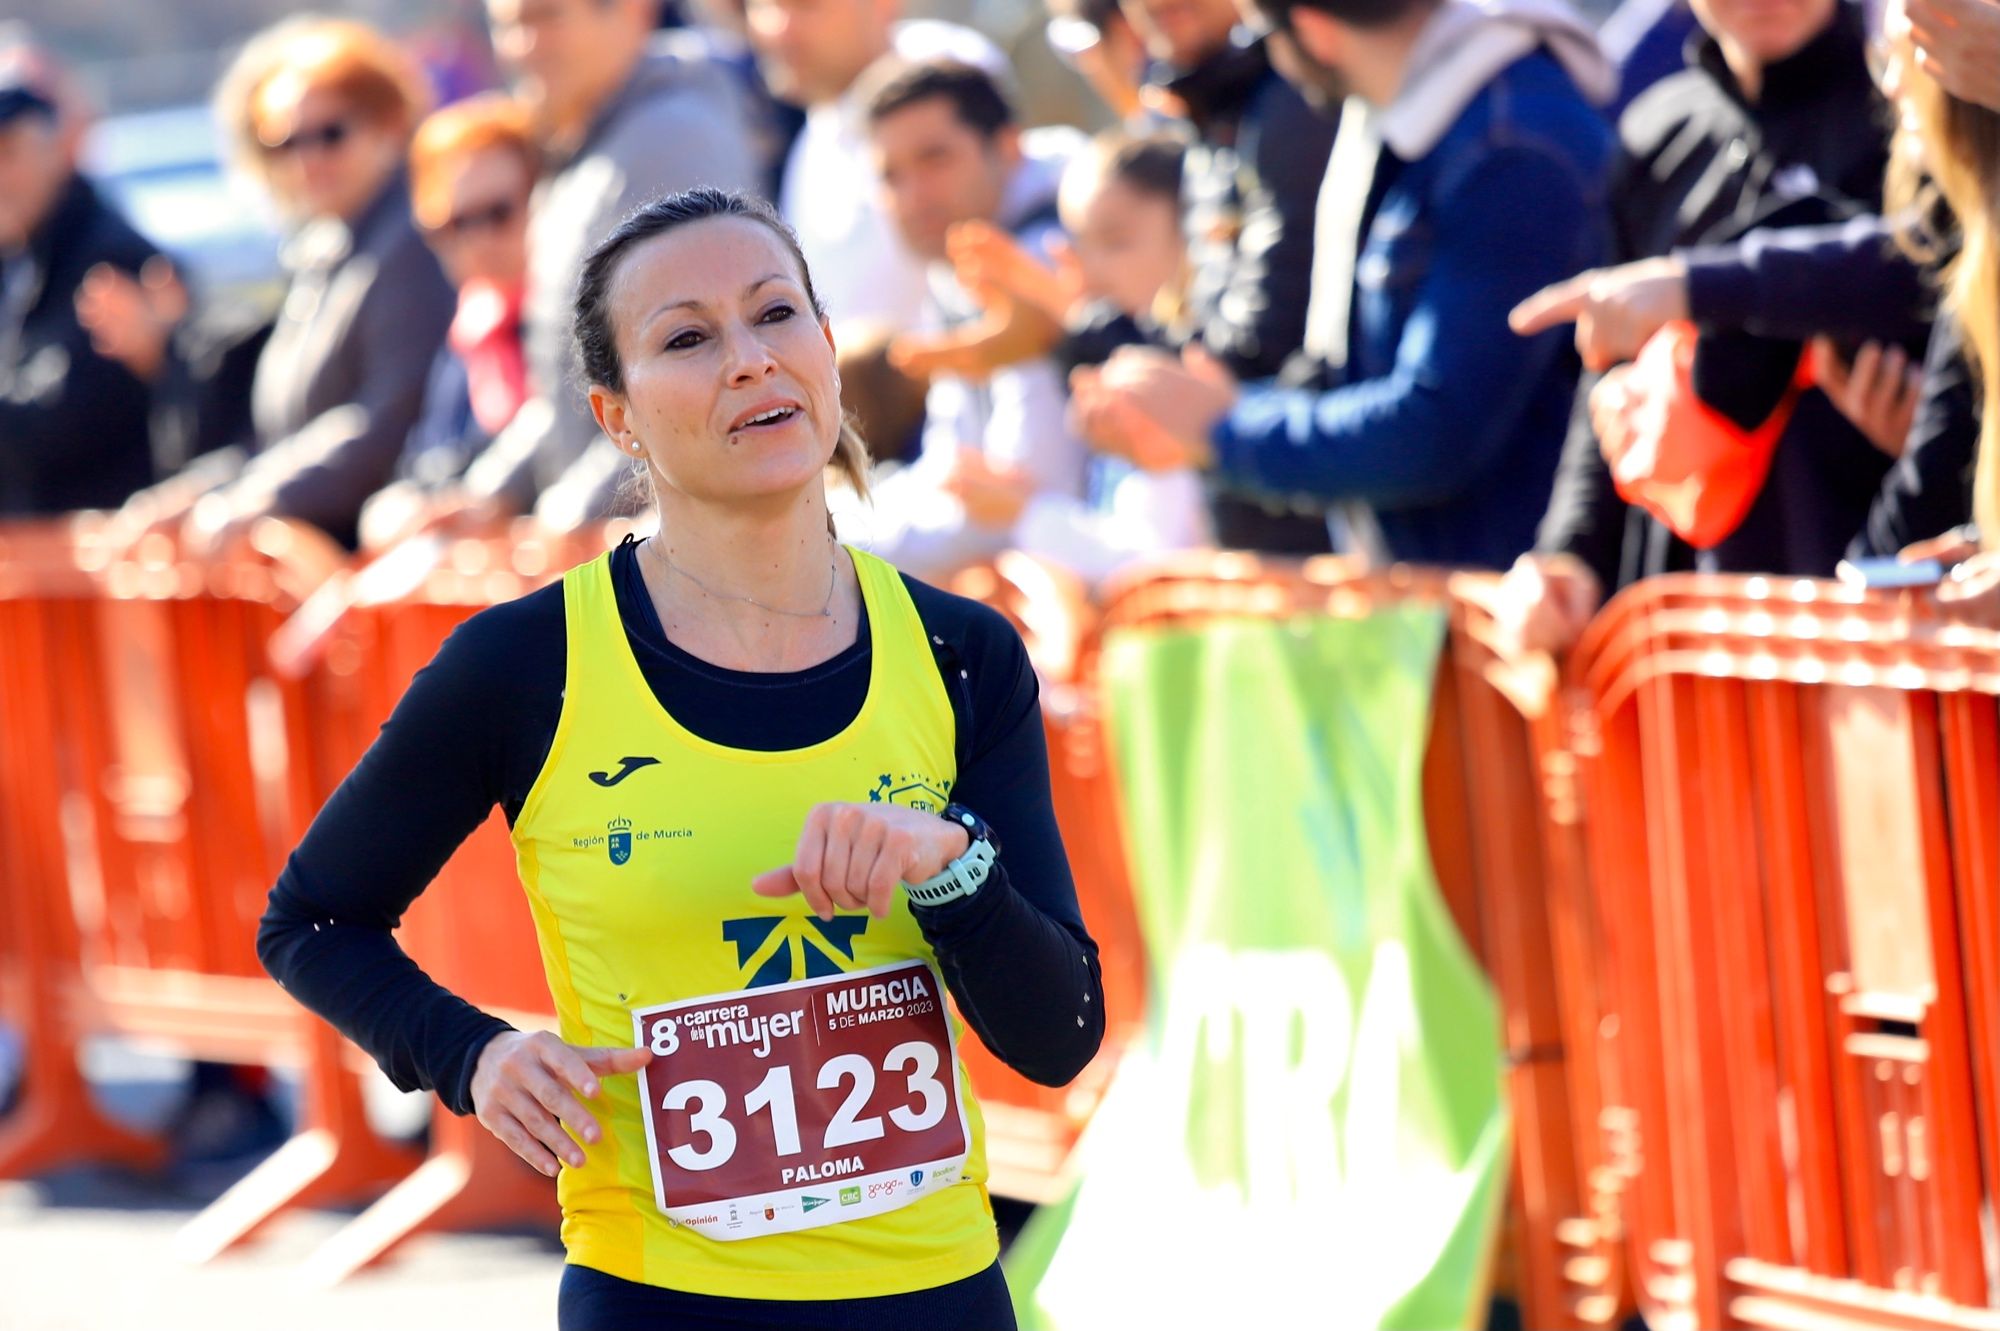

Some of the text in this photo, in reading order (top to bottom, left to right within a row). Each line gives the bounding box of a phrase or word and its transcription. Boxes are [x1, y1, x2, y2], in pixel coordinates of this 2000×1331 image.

[573, 827, 693, 849] Región de Murcia
[826, 975, 929, 1016] MURCIA
[683, 1004, 749, 1026] carrera
[828, 1000, 934, 1031] 5 DE MARZO 2023
[704, 1009, 804, 1058] mujer
[661, 1041, 948, 1171] 3123
[781, 1155, 865, 1185] PALOMA
